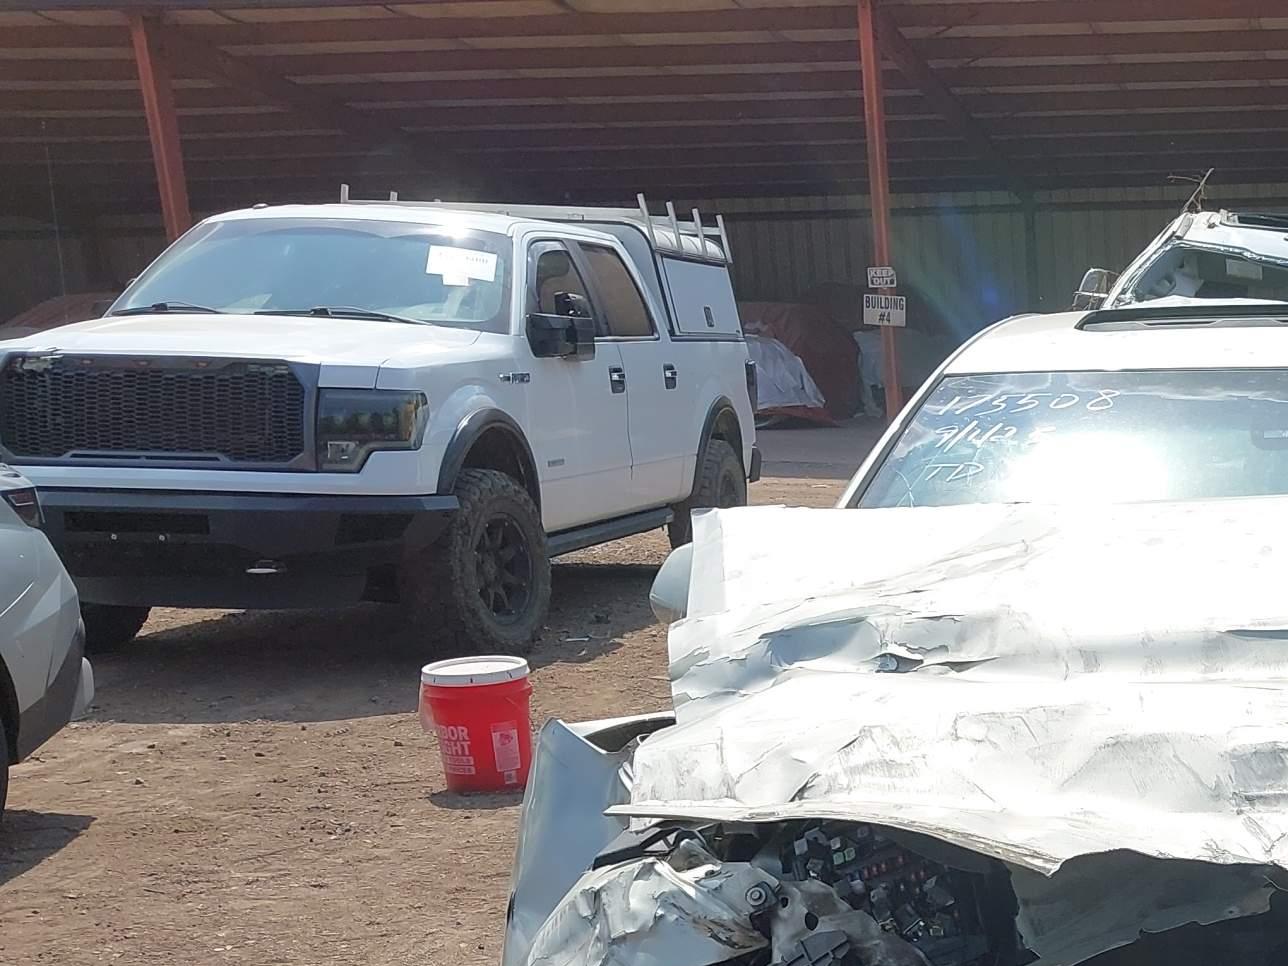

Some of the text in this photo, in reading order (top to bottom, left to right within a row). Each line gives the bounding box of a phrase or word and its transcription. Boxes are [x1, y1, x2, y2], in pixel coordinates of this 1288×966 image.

[869, 270, 894, 278] KEEP
[865, 296, 904, 310] BUILDING
[878, 312, 891, 324] #4
[437, 725, 470, 740] BOR
